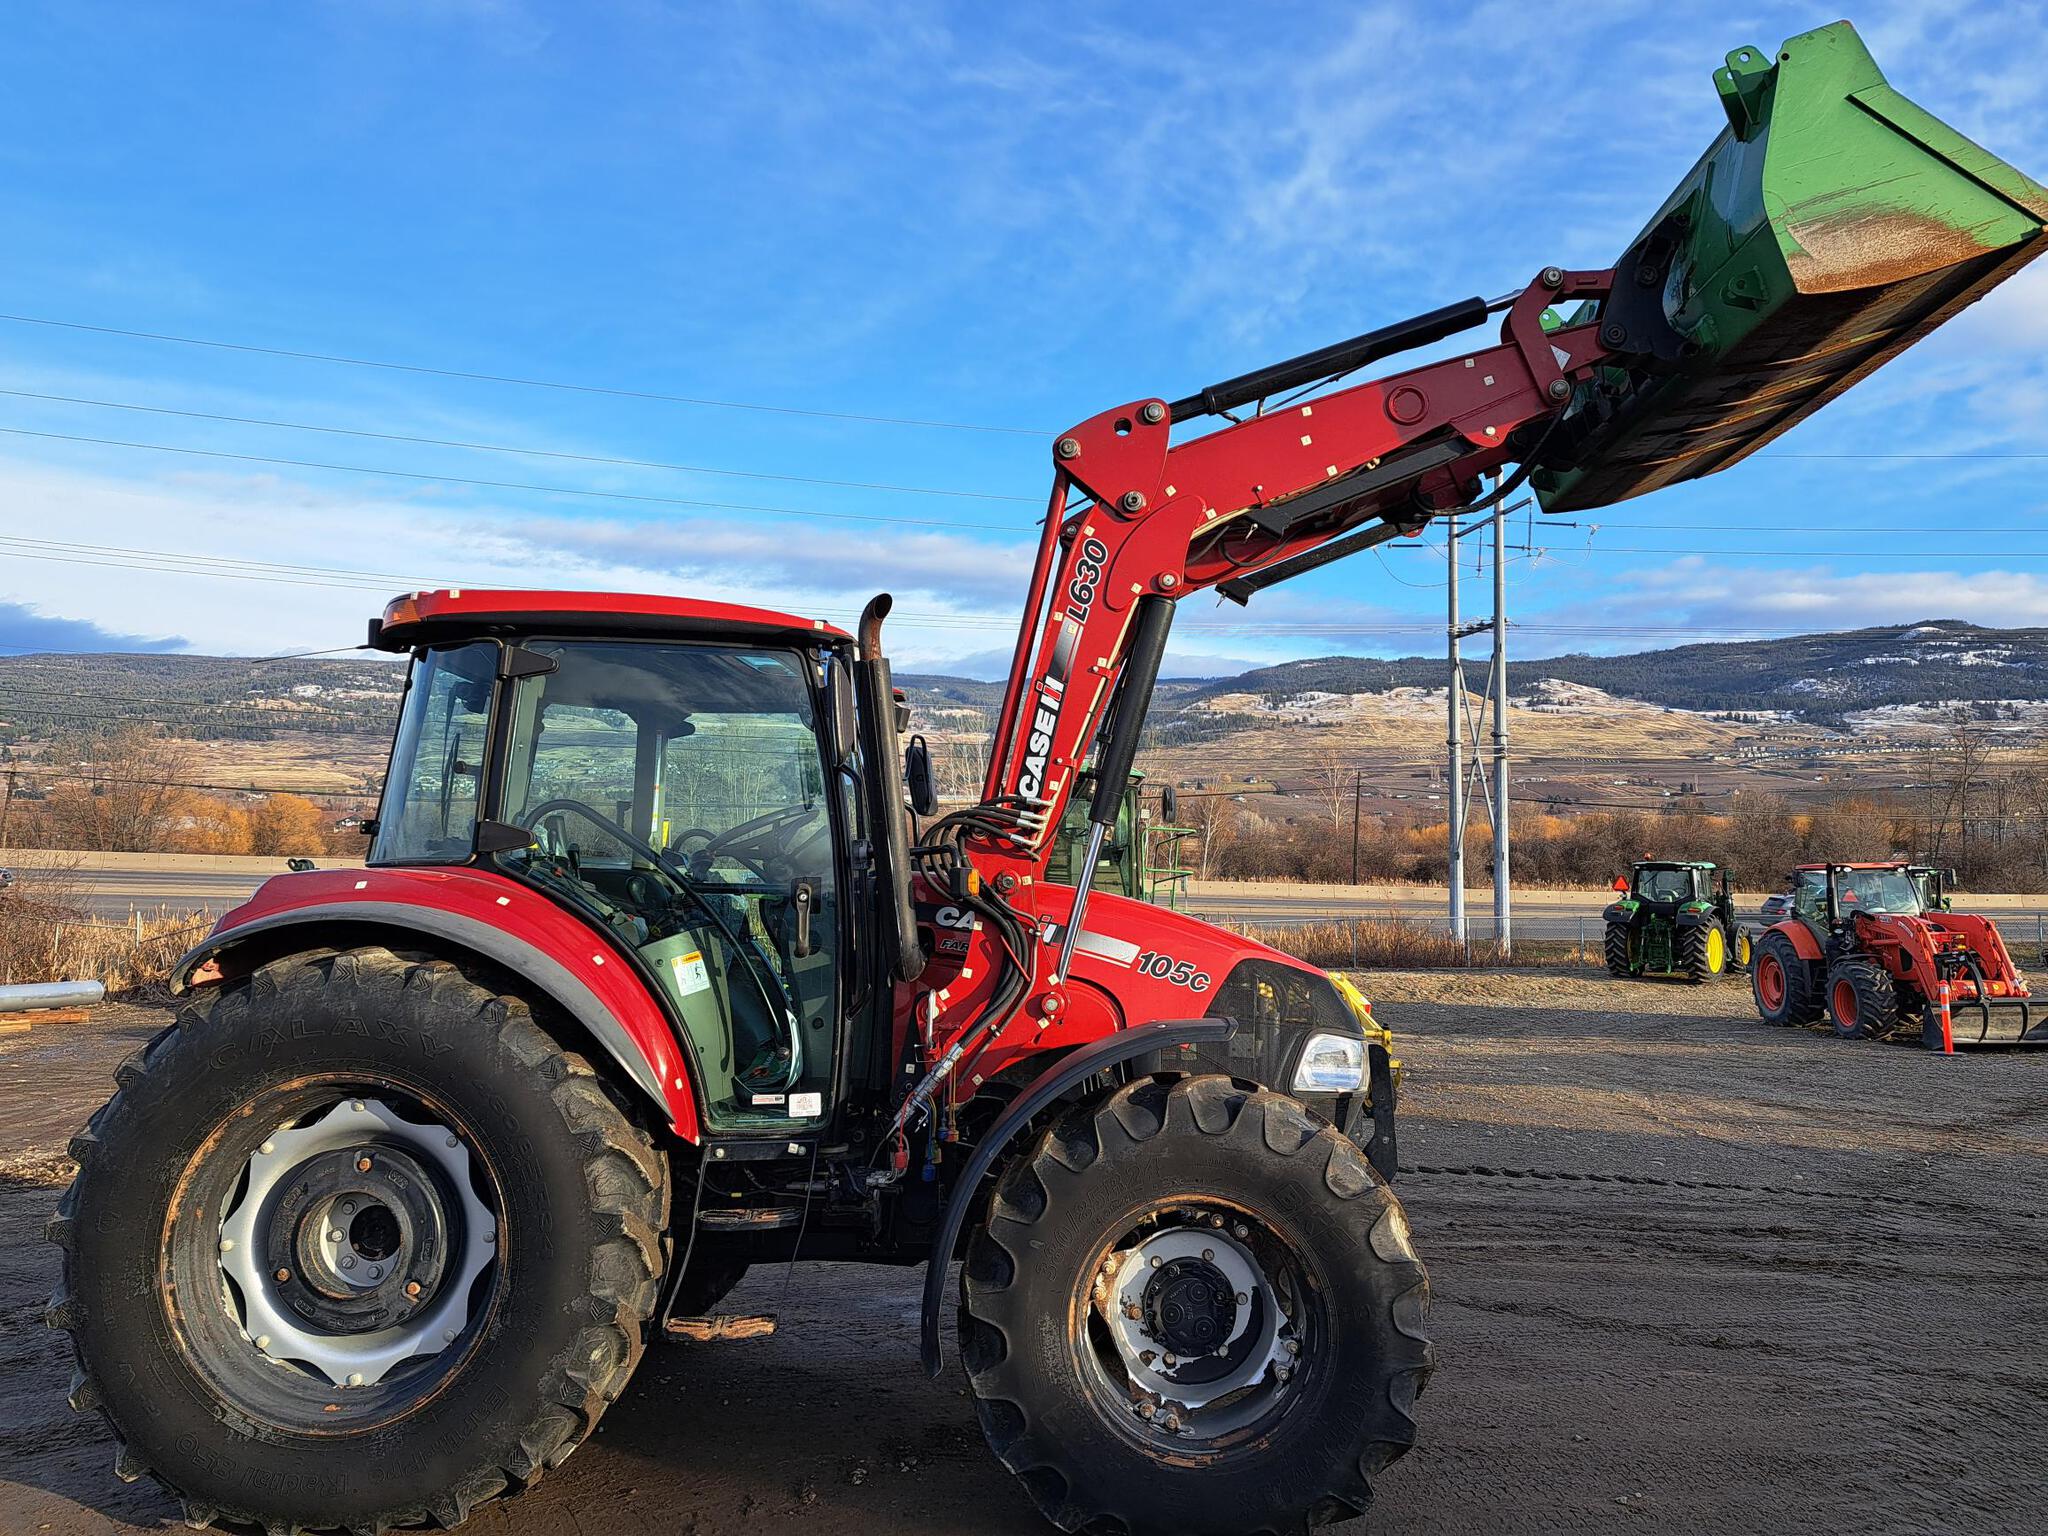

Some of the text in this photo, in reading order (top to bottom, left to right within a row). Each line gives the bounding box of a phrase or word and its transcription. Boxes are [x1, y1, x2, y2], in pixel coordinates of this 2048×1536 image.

[1067, 538, 1108, 624] L630
[1019, 707, 1057, 799] CASE
[935, 906, 976, 931] CA
[939, 938, 970, 953] FAR
[209, 1015, 456, 1071] GALAXY
